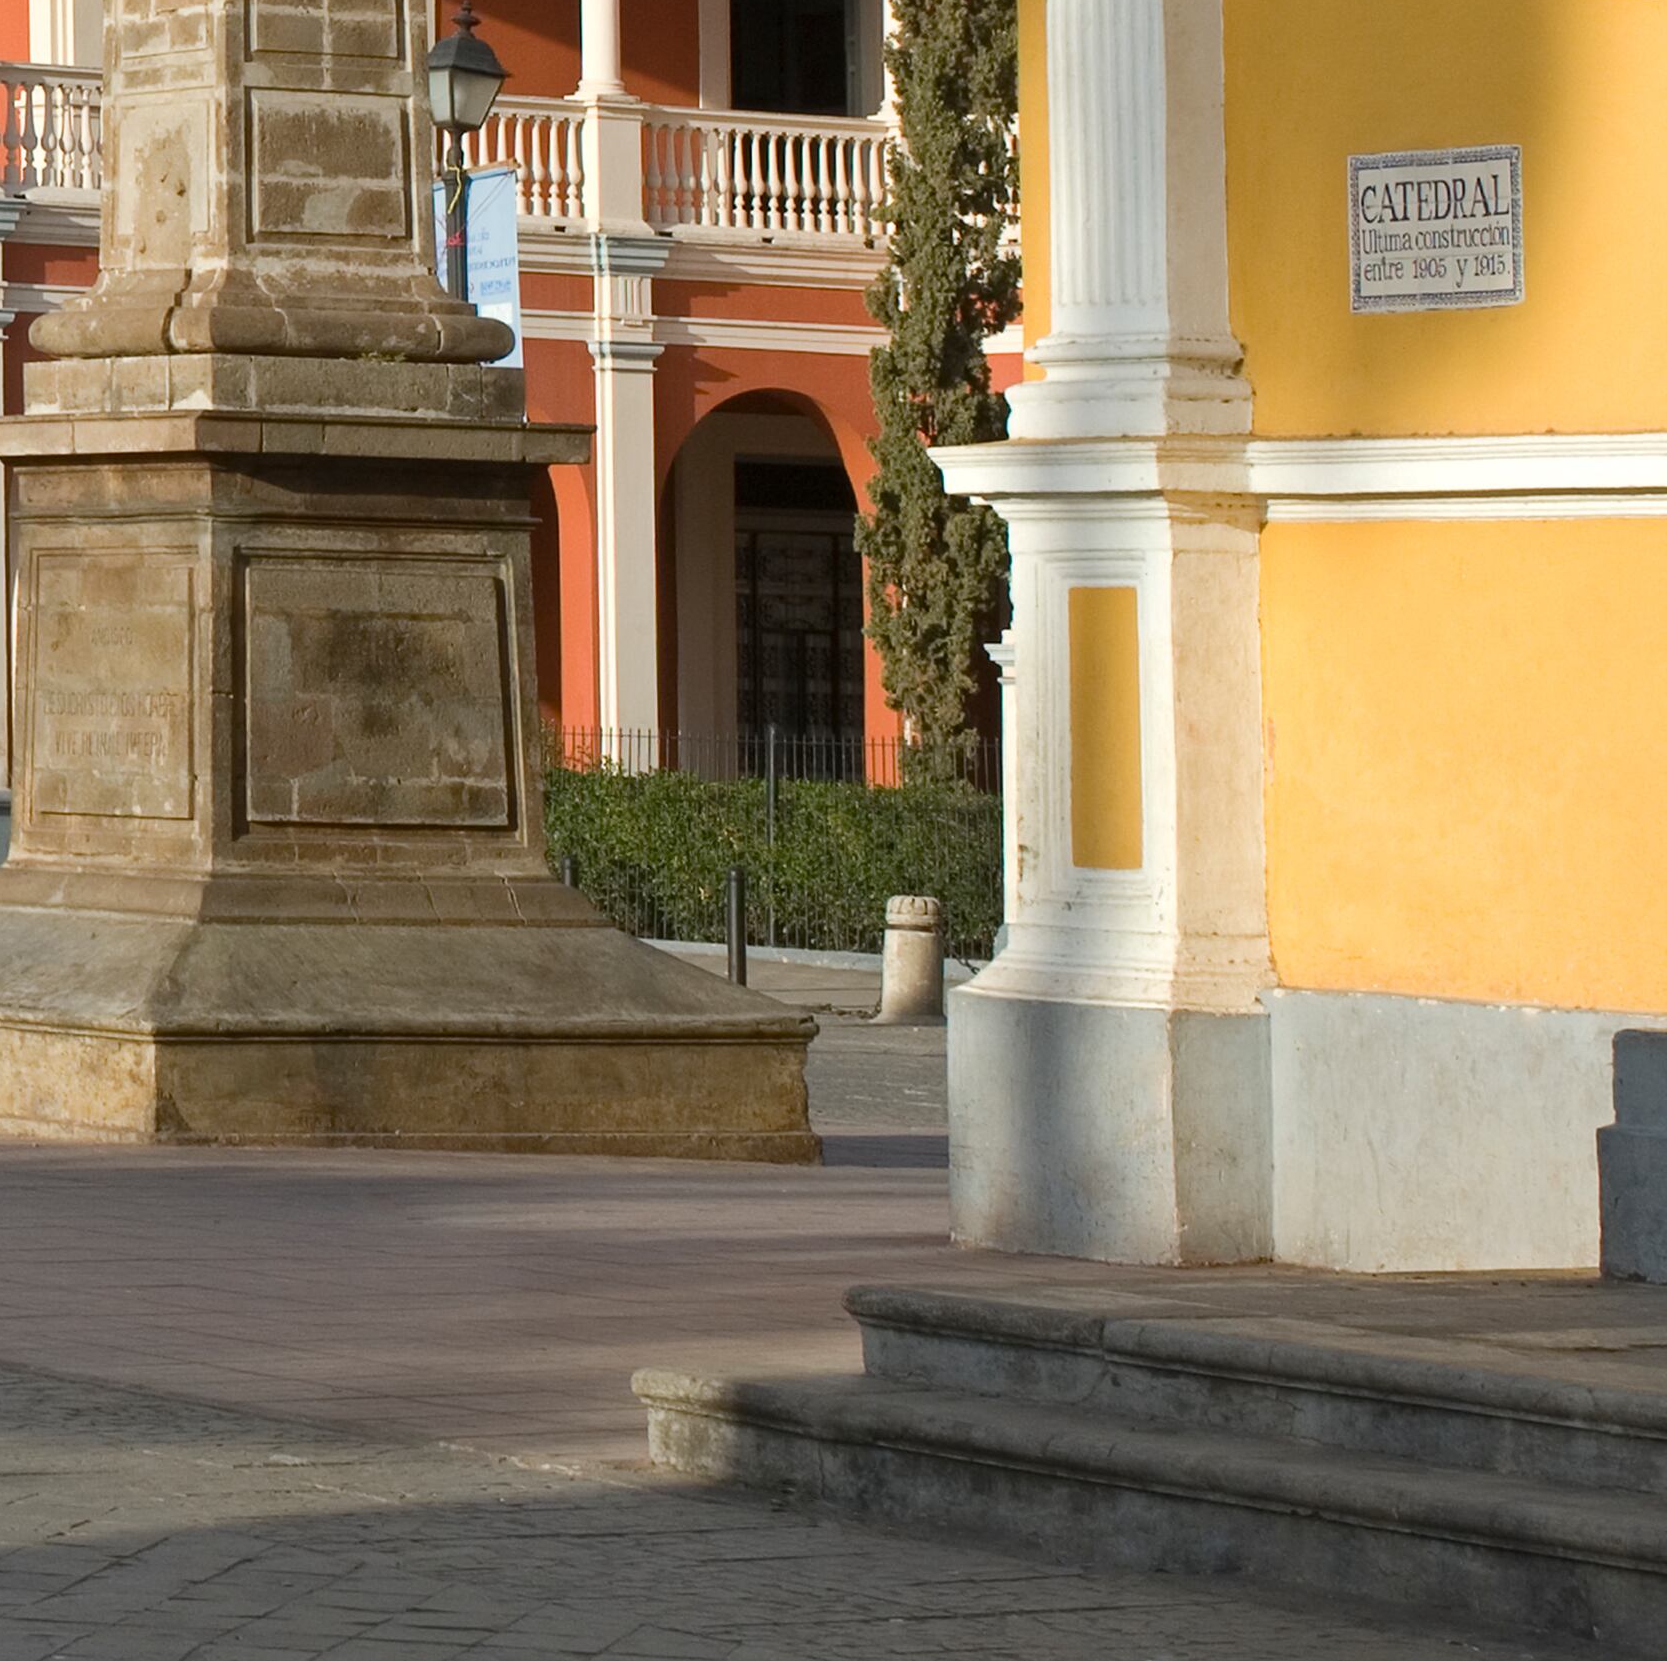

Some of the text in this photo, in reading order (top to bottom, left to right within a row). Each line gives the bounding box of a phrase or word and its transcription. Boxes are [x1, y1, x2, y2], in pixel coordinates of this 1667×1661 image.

[1361, 174, 1509, 224] CATEDRAL
[1362, 221, 1510, 255] Ultima construcción
[1364, 256, 1404, 282] entre
[1413, 258, 1446, 279] 1905
[1456, 258, 1469, 288] y
